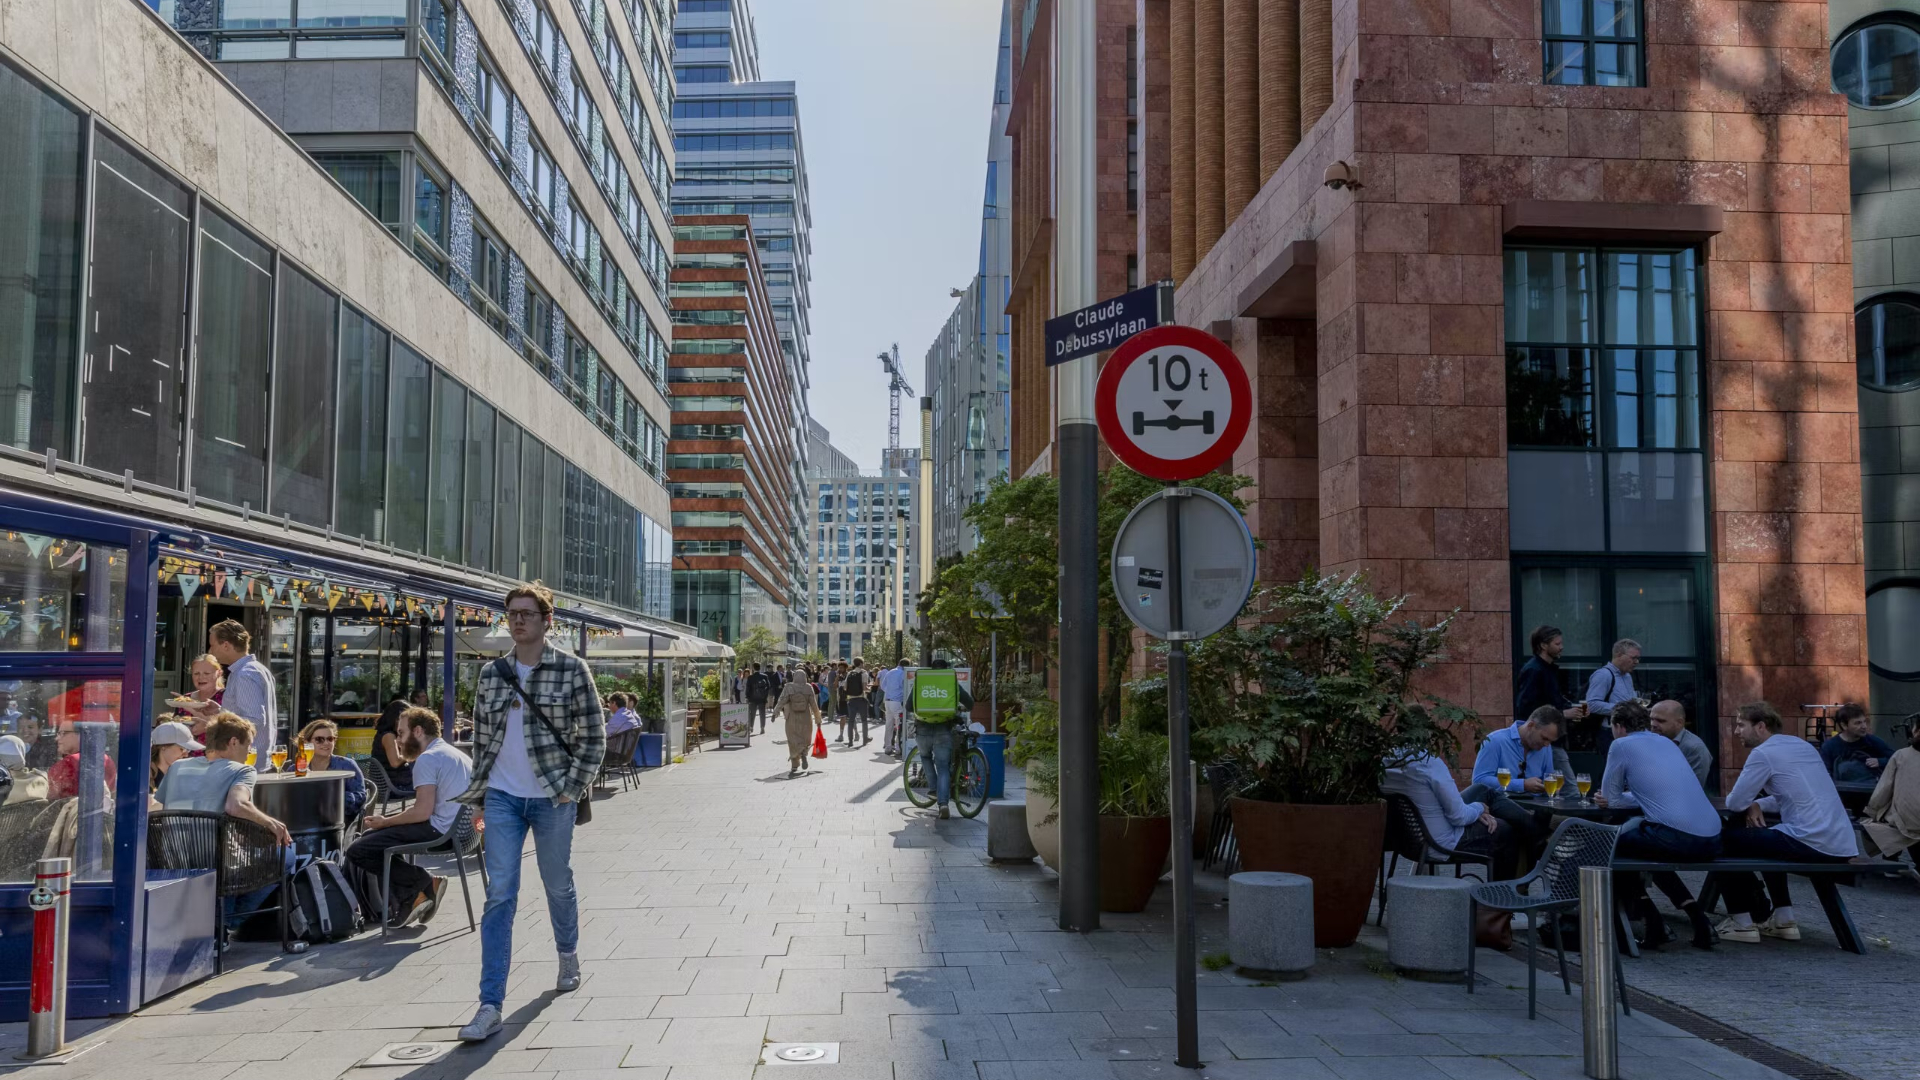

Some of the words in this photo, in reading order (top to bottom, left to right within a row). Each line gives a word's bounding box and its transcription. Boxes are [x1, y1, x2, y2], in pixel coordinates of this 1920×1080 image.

[1075, 300, 1124, 328] Claude
[1055, 317, 1147, 356] Debussylaan
[1148, 354, 1191, 392] 10
[1199, 367, 1209, 391] t
[701, 610, 727, 624] 247
[921, 687, 948, 699] eats
